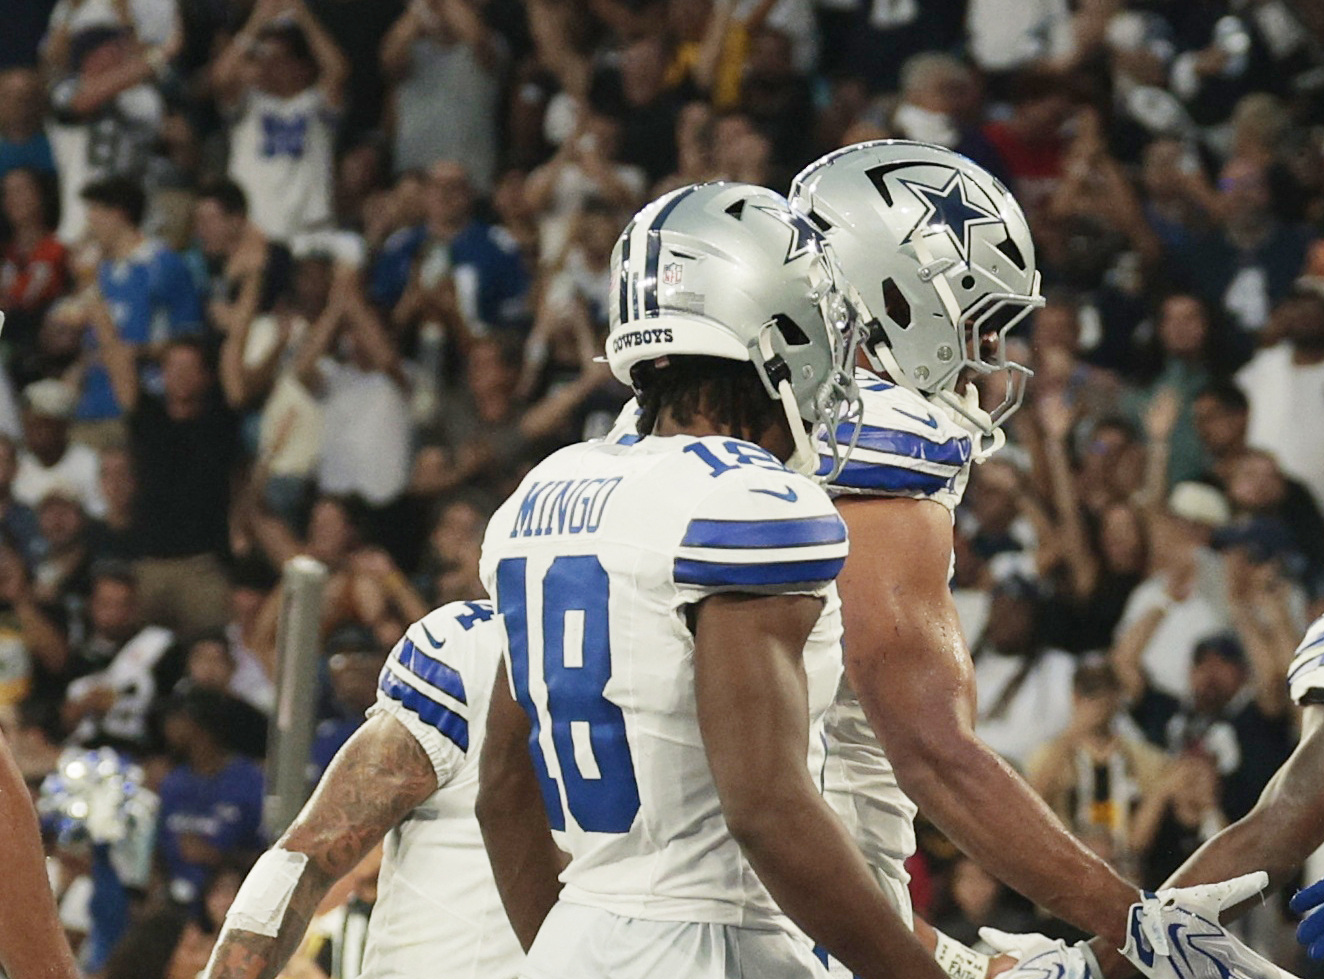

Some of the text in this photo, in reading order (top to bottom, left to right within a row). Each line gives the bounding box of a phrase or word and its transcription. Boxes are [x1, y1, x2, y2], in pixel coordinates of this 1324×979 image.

[613, 328, 674, 354] COWBOYS
[510, 476, 624, 539] MINGO
[495, 554, 642, 833] 18
